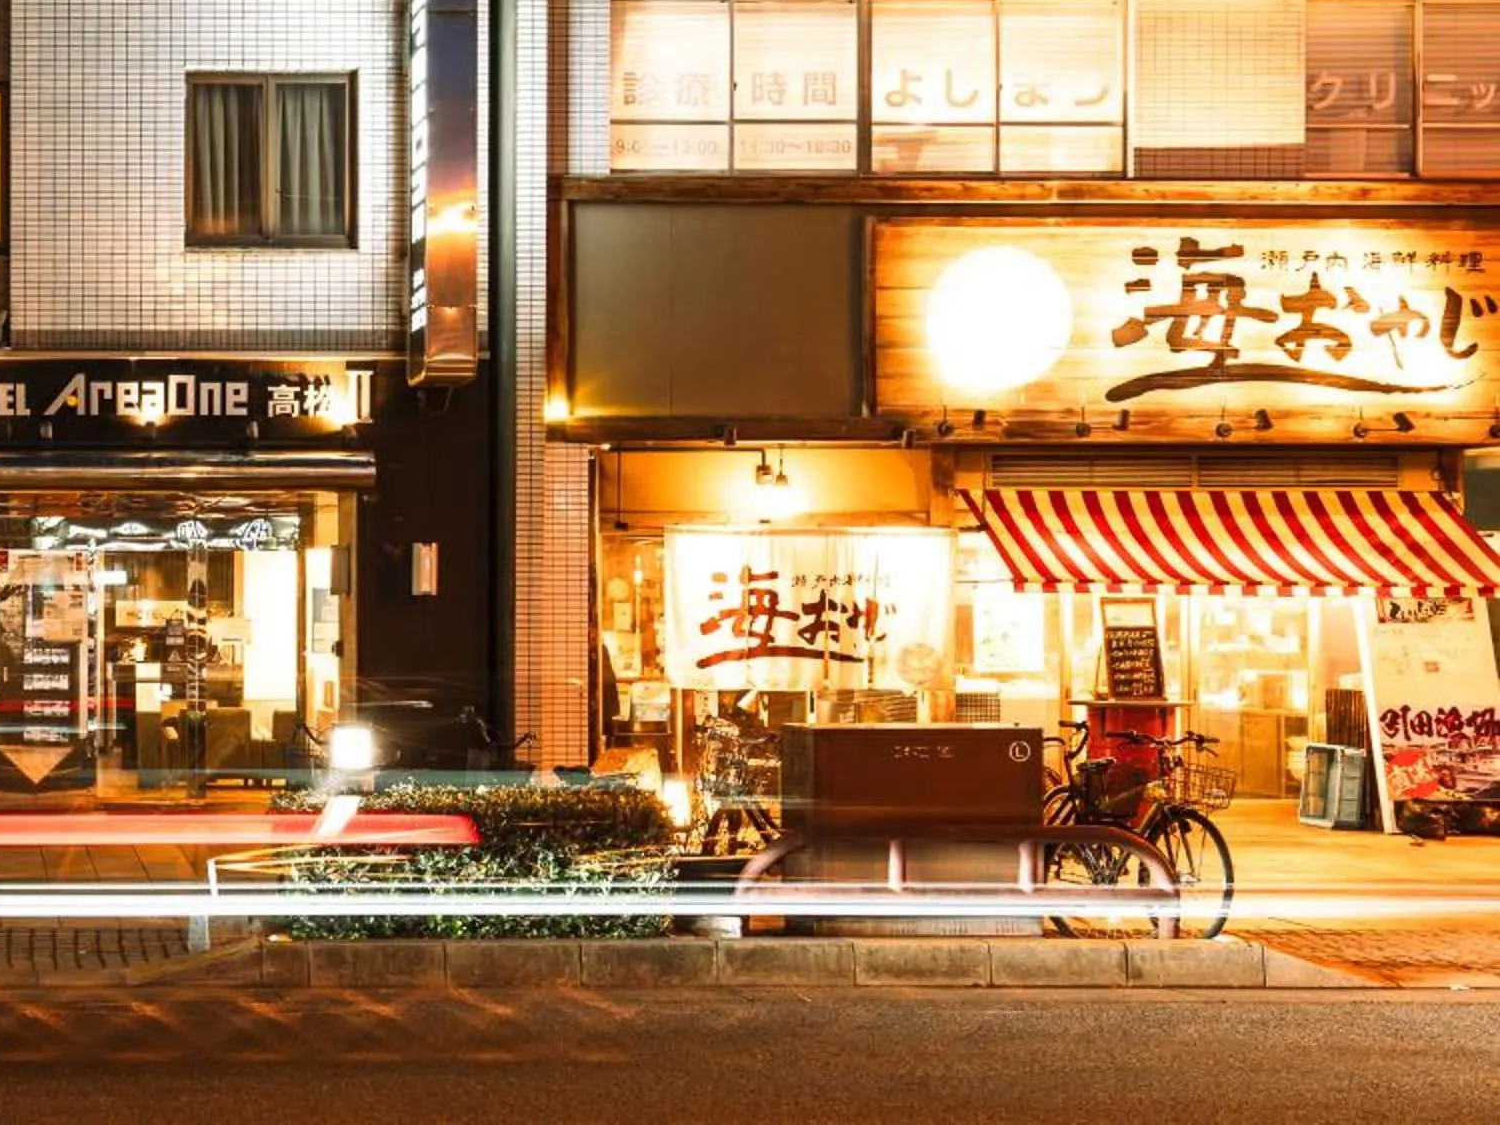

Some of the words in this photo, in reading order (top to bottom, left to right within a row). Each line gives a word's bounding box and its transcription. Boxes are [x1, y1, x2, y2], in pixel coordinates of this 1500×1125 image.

[1111, 237, 1498, 369] 海おやじ
[44, 373, 249, 416] AreaOne
